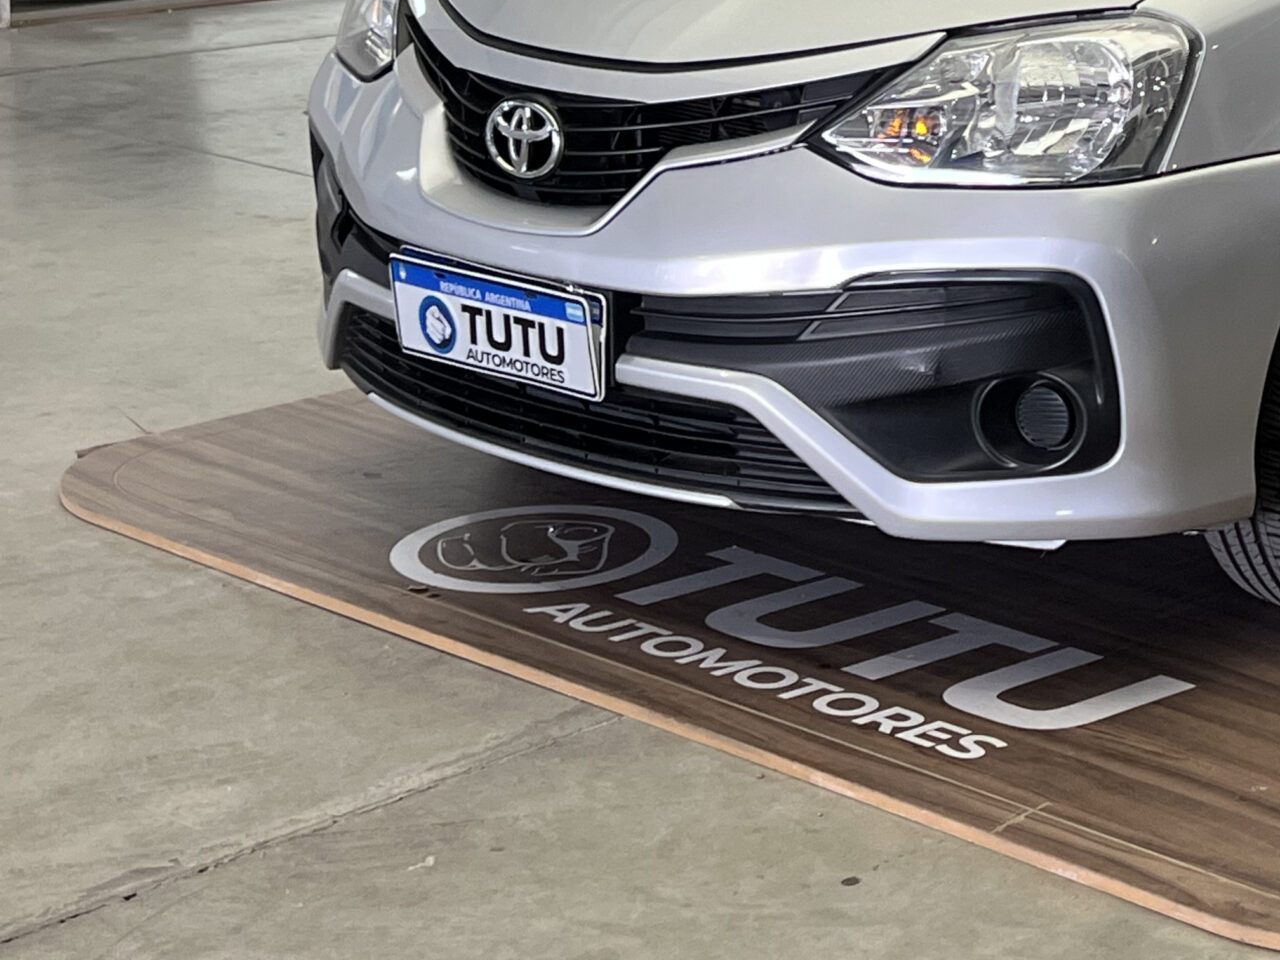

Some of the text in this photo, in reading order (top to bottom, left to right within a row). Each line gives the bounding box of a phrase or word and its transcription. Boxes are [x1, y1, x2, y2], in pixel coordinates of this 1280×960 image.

[484, 291, 532, 313] ARGENTINA
[461, 303, 566, 366] TUTU
[466, 347, 566, 385] AUTOMOTORES
[615, 544, 1197, 731] TUTU
[523, 602, 1009, 761] AUTOMOTORES
